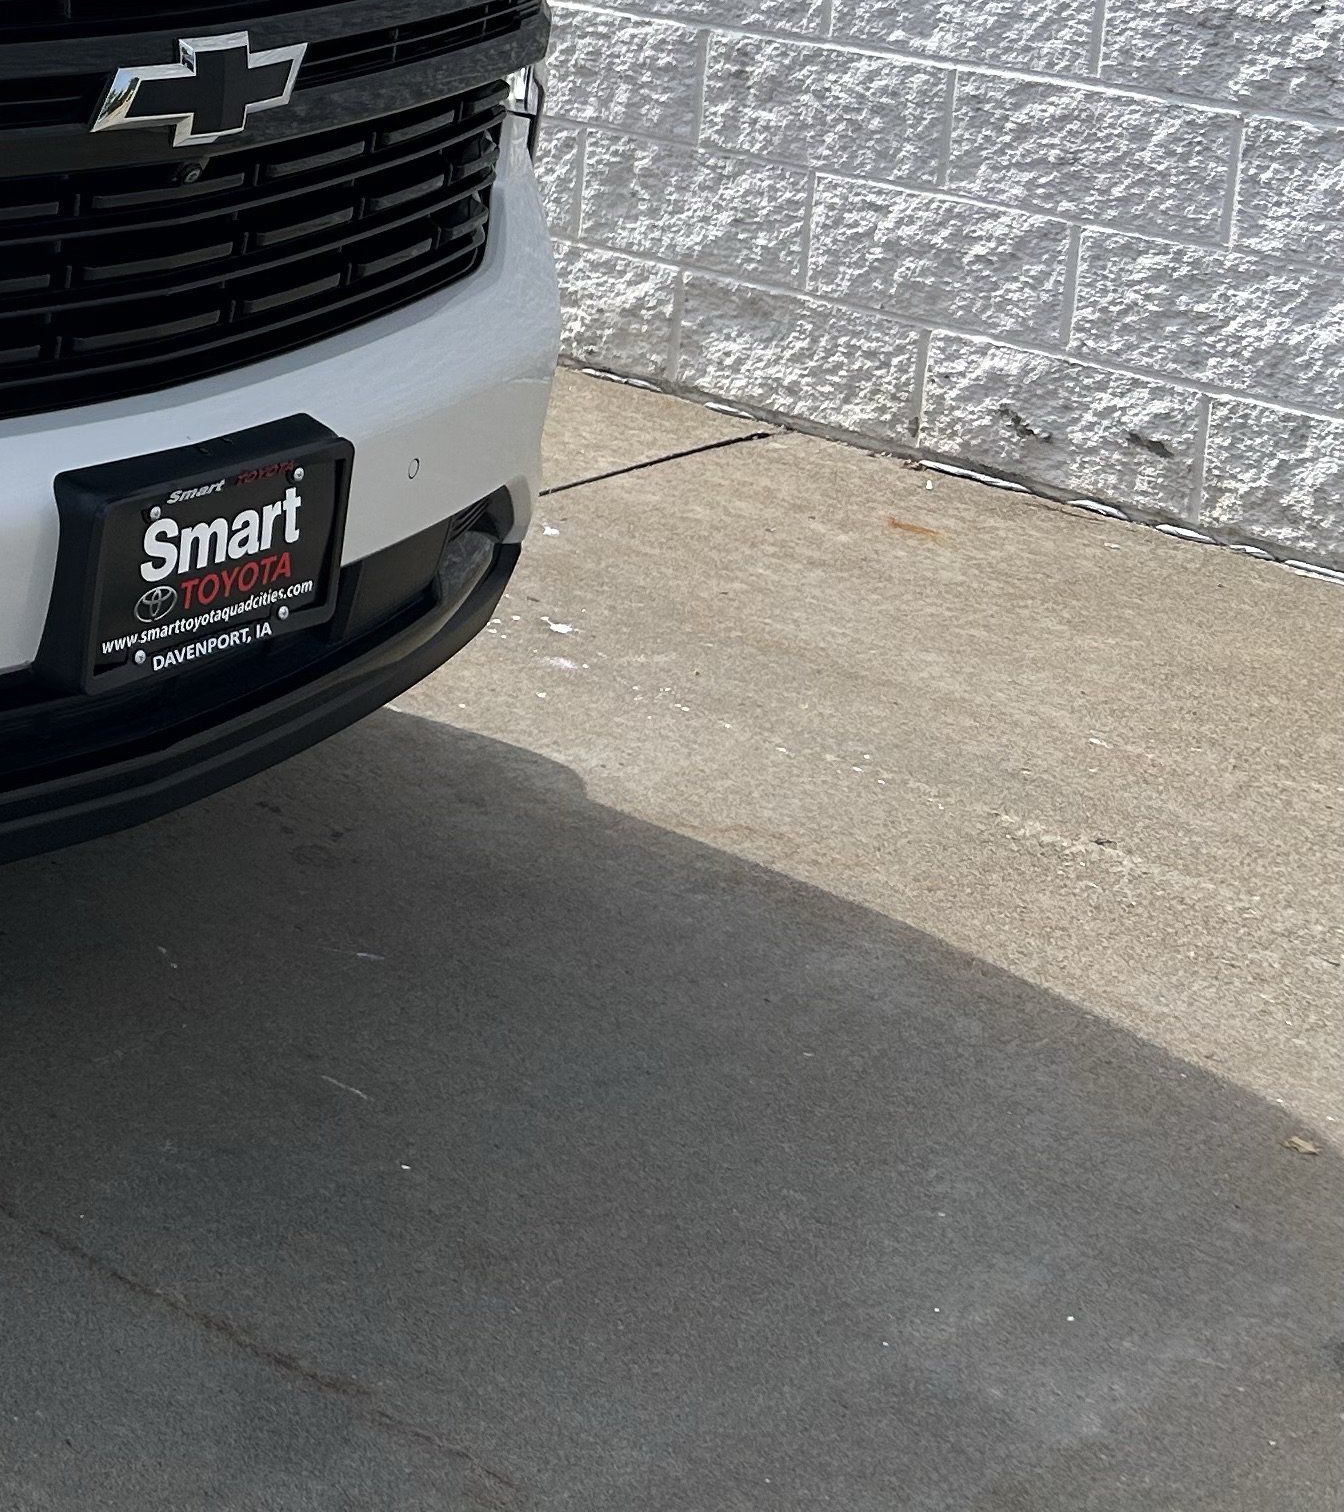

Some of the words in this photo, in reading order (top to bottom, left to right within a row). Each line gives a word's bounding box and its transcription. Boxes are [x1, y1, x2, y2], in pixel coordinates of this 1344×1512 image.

[166, 478, 226, 504] Smart
[235, 459, 295, 486] TOYOTA
[140, 487, 302, 582] Smart
[179, 552, 292, 609] TOYOTA
[101, 579, 314, 656] www.smarttoyotaquadcities.com
[152, 626, 252, 672] DAVENPORT,
[255, 621, 273, 638] IA
